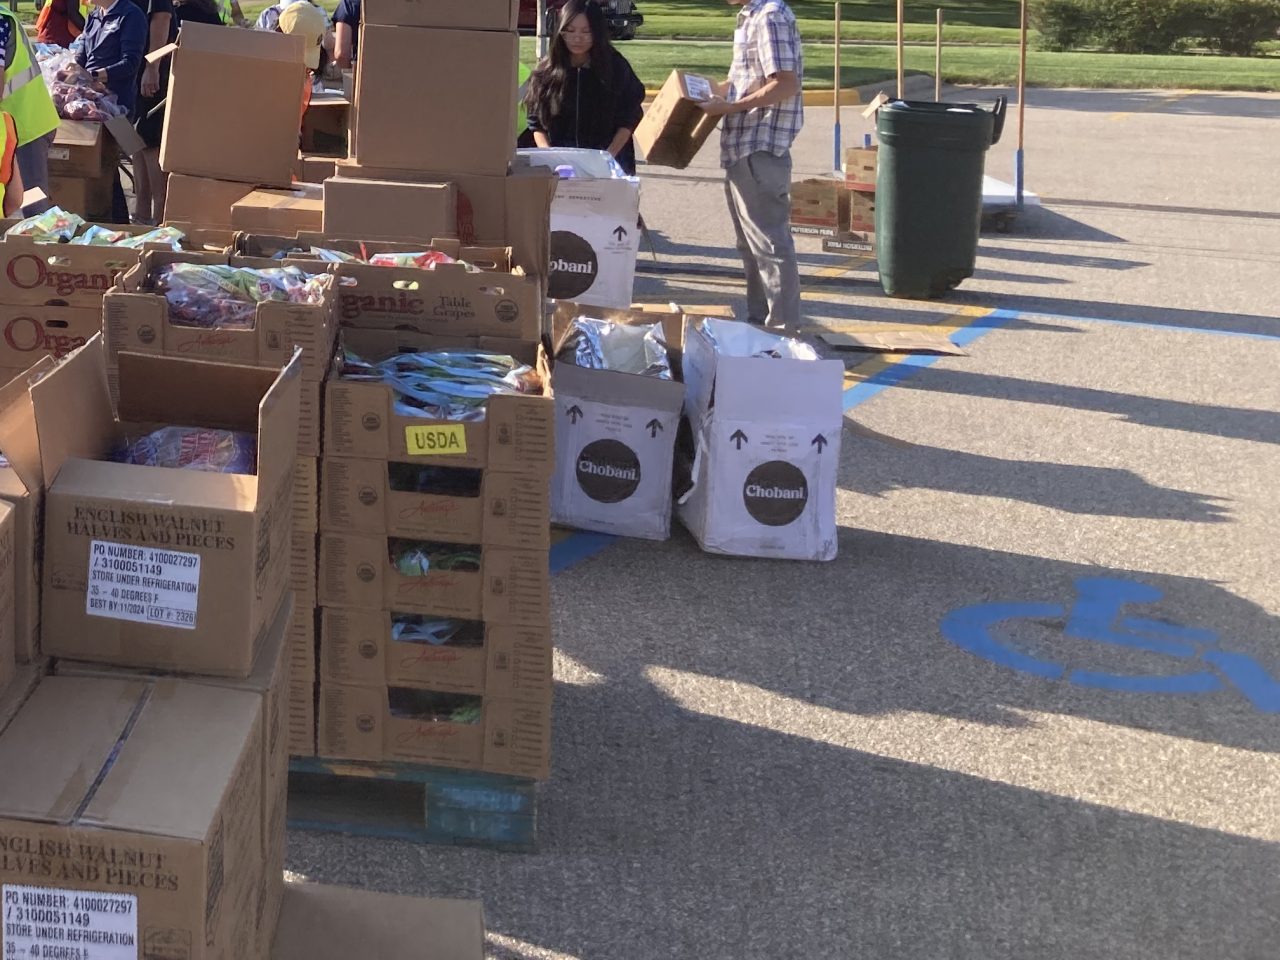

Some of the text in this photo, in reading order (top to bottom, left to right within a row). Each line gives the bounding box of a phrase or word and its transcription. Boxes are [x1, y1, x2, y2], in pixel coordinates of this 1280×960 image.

[6, 254, 119, 297] Organi
[549, 259, 592, 274] obani
[340, 292, 425, 319] ganic
[439, 295, 472, 309] Table
[432, 307, 476, 321] Grapes
[415, 432, 460, 450] USDA
[75, 508, 225, 535] ENGLISH WALNUT
[68, 521, 235, 549] HALVES AND PIECES
[94, 545, 197, 568] PO NUMBER: 4100027297
[101, 557, 161, 576] 3100051149
[92, 570, 196, 593] STORE UNDER REFRIGERATION
[92, 585, 99, 595] 35
[111, 587, 118, 598] 40
[121, 589, 152, 602] DEGREES
[91, 598, 106, 609] BEST
[150, 607, 163, 617] LOT
[175, 611, 194, 622] 2326
[79, 844, 166, 870] WALNUT
[58, 860, 98, 881] AND
[106, 866, 178, 890] PIECES
[6, 892, 132, 914] PO NUMBER: 4100027297
[16, 907, 90, 926] 3100051149
[6, 923, 32, 936] STORE
[36, 925, 65, 939] UNDER
[68, 928, 134, 945] REFRIGERATION
[43, 945, 81, 959] DEGREES
